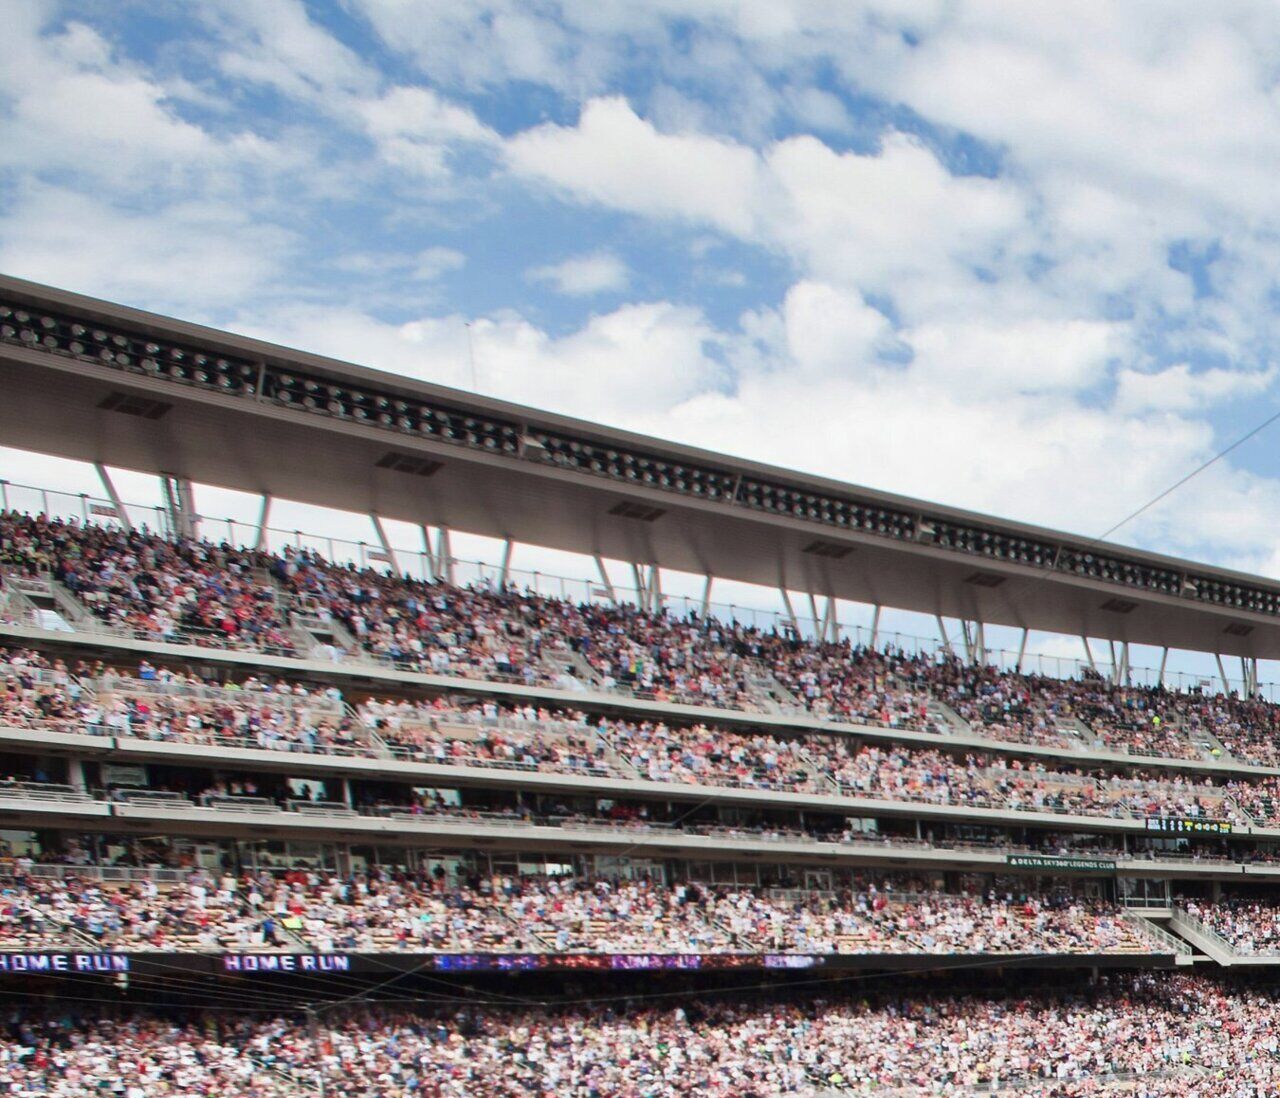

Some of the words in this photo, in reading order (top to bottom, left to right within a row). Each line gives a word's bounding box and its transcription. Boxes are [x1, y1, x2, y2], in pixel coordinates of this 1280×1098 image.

[76, 955, 129, 971] RUN
[225, 955, 294, 970] HOME
[301, 955, 348, 970] RUN
